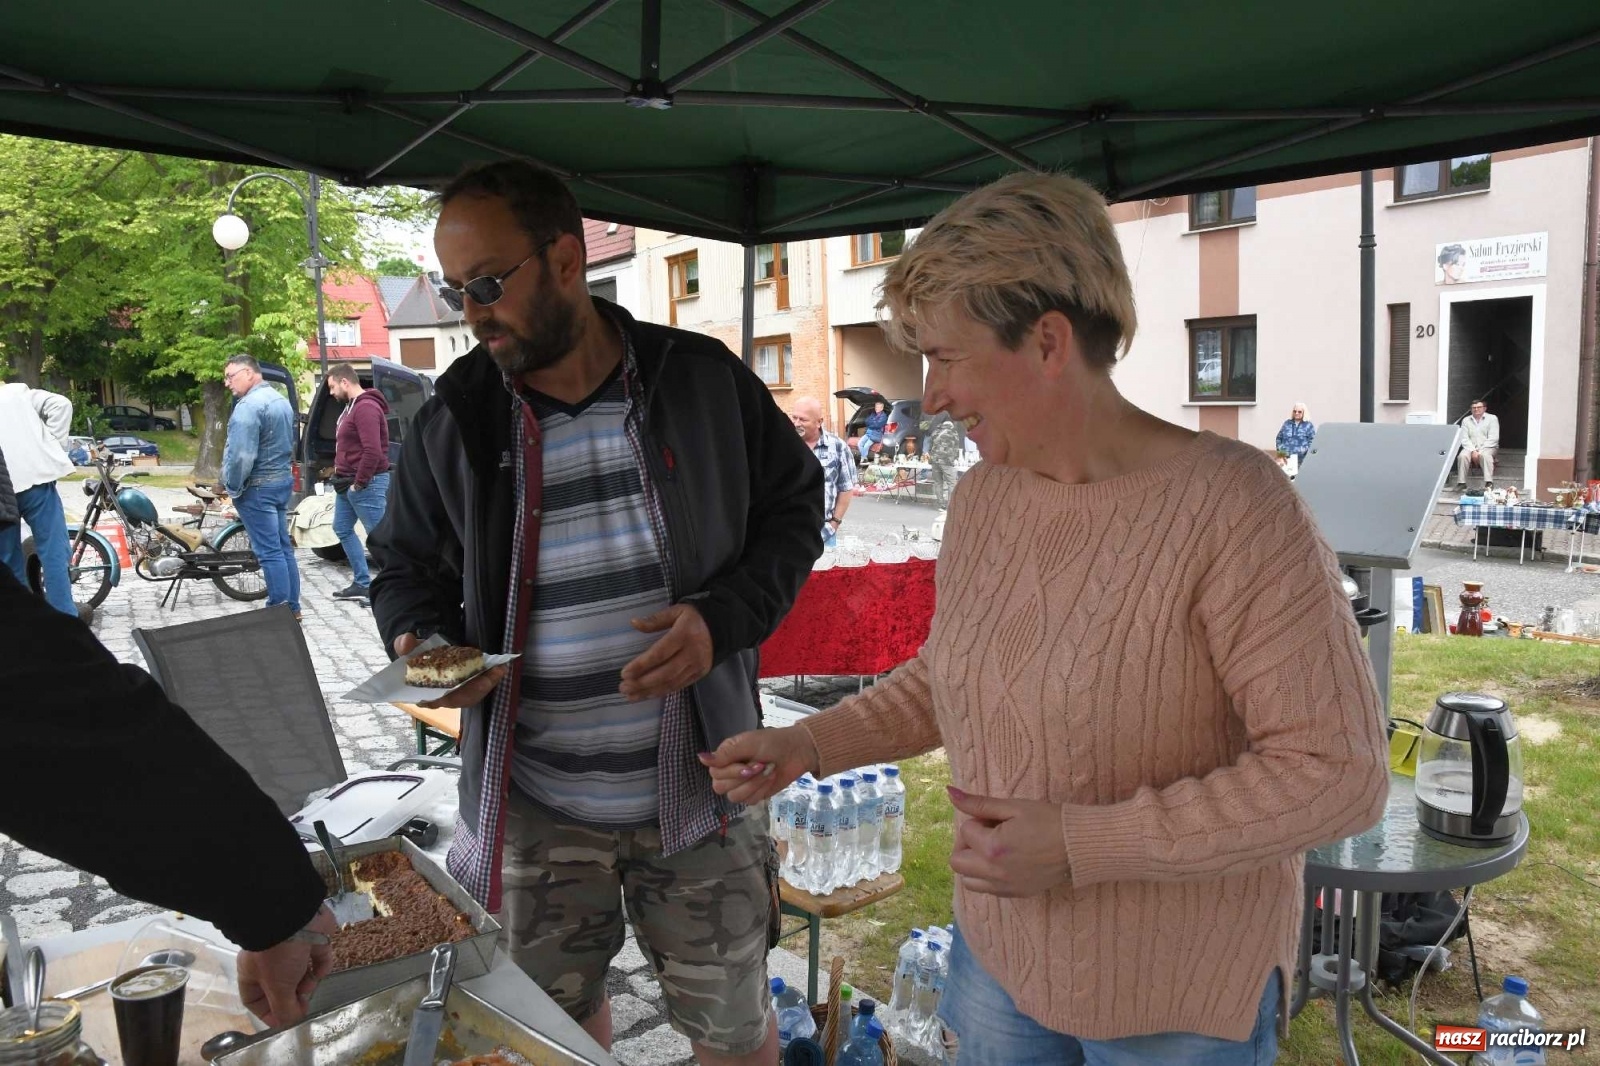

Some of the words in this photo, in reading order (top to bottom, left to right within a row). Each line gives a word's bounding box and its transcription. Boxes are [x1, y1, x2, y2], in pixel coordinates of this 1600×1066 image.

[1469, 243, 1492, 258] Salon
[1496, 237, 1542, 257] Fryzjerski
[1416, 324, 1435, 339] 20
